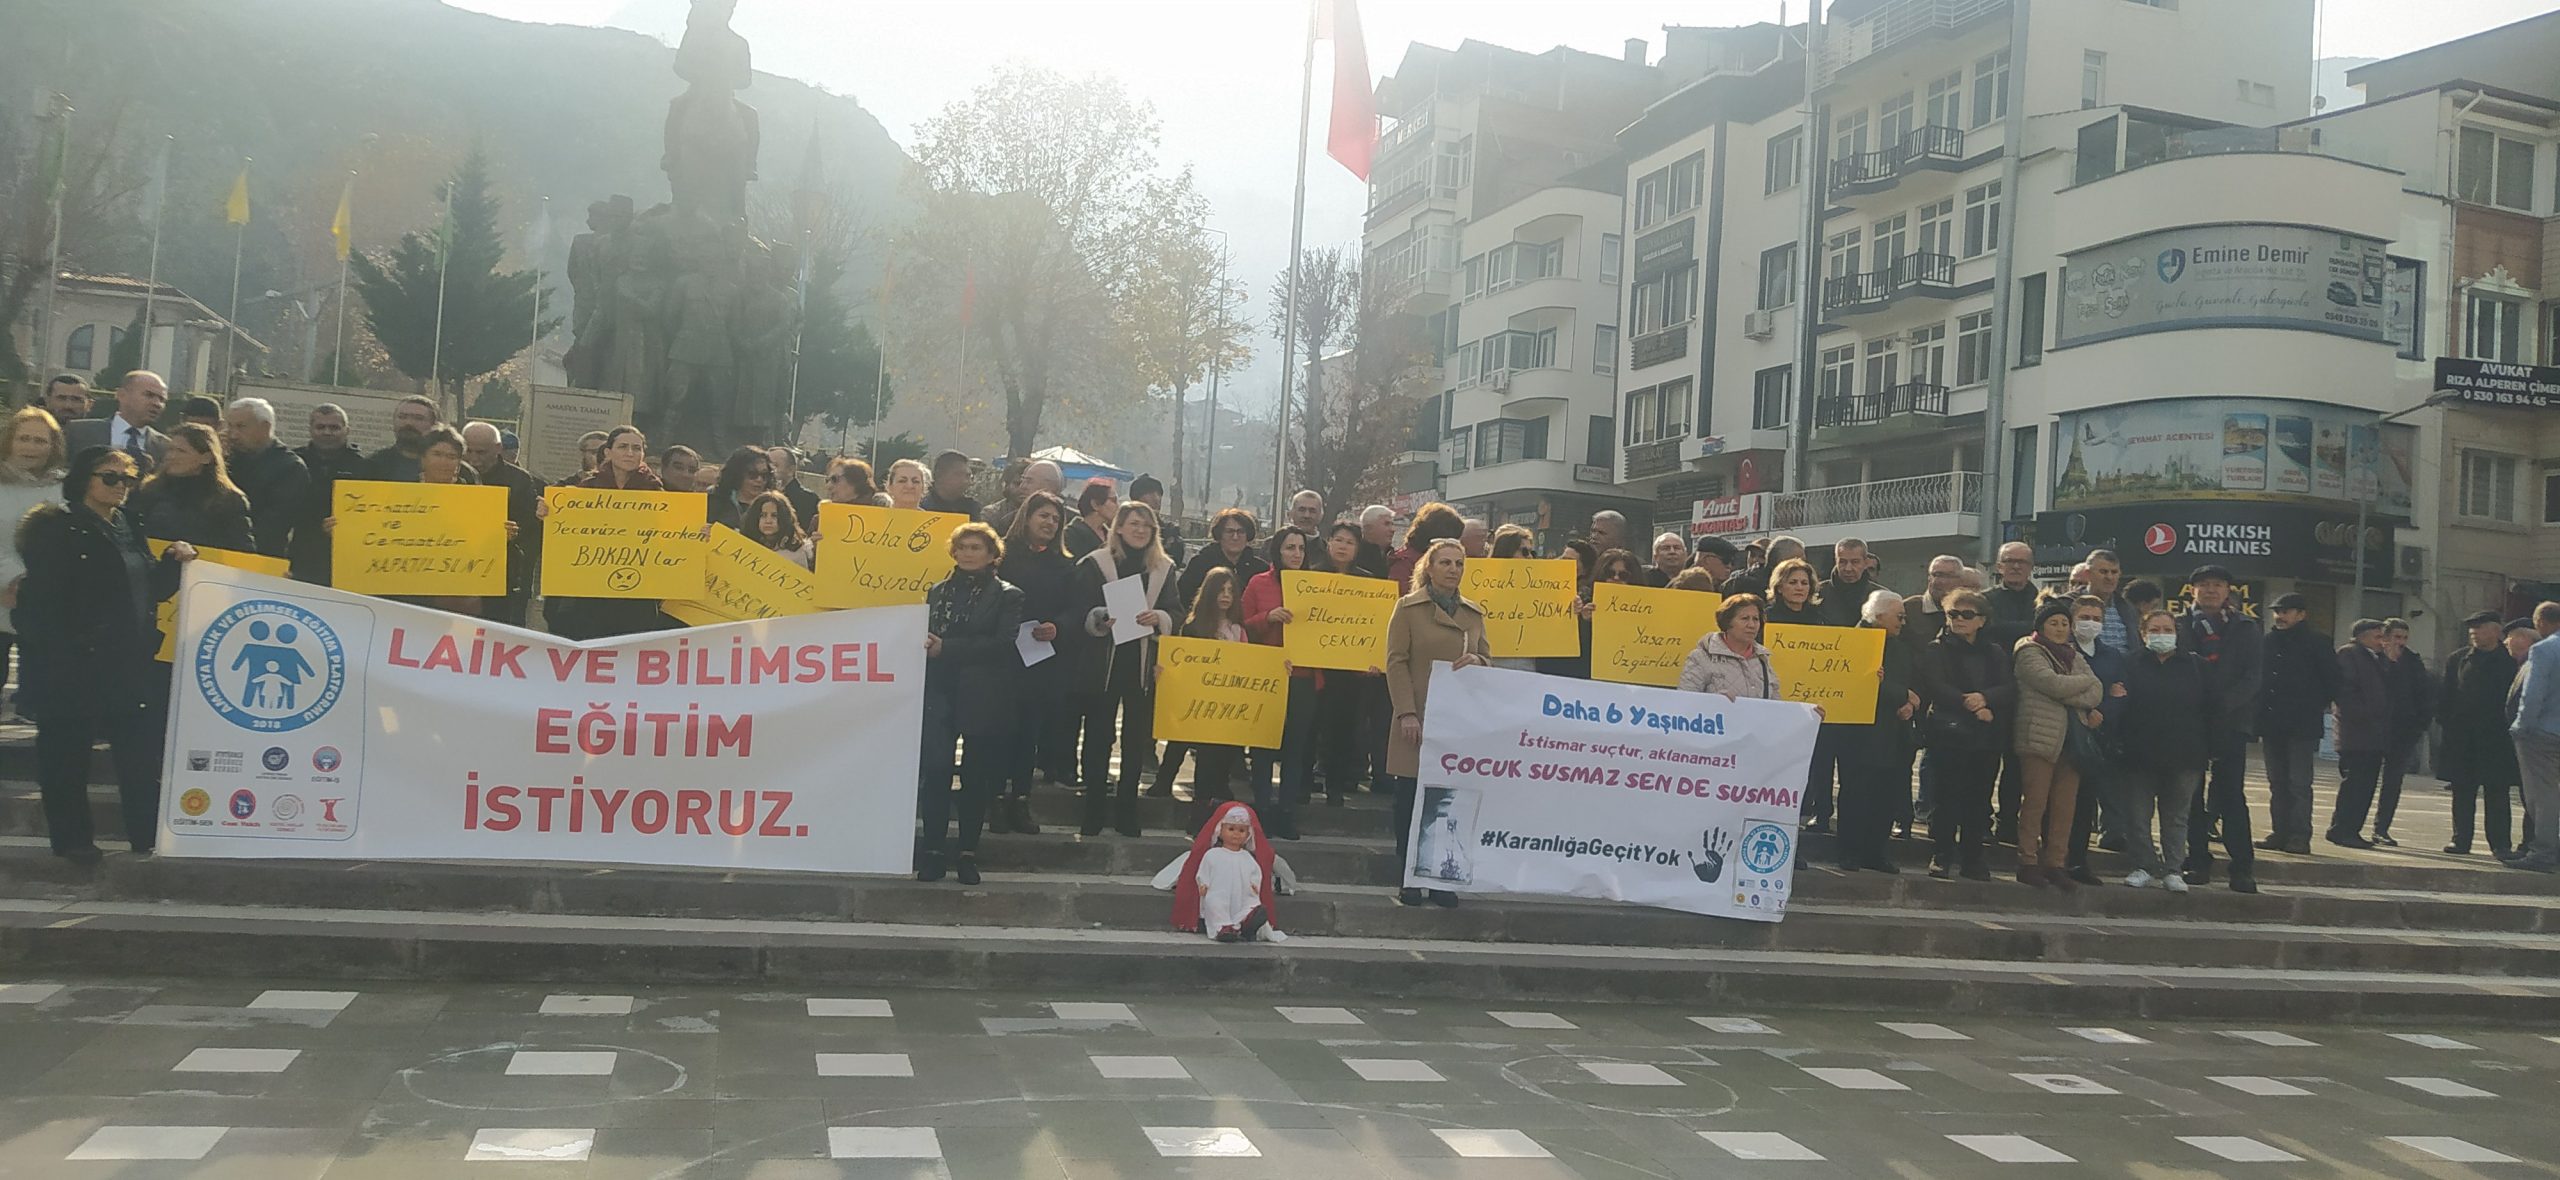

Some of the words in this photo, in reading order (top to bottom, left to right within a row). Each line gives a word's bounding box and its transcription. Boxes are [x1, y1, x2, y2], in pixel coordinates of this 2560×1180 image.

[2193, 245, 2250, 264] Emine
[2258, 244, 2309, 264] Demir
[2480, 363, 2533, 378] AVUKAT
[2446, 375, 2474, 387] RIZA
[2475, 378, 2527, 392] ALPEREN
[545, 403, 578, 413] AMASYA
[2463, 389, 2471, 400] 0
[2474, 391, 2493, 401] 530
[2496, 392, 2513, 404] 163
[2515, 394, 2531, 405] 94
[2532, 396, 2547, 407] 45
[552, 492, 669, 514] Çocuklarımız
[1703, 498, 1739, 517] Anıt
[381, 520, 402, 530] ve
[552, 520, 627, 537] Tecavüze
[841, 514, 901, 548] Daha
[908, 515, 942, 553] 6
[1691, 515, 1748, 535] LOKANTASI
[2185, 523, 2271, 540] TURKISH
[2184, 539, 2272, 556] AIRLINES
[1471, 568, 1516, 590] Çocuk
[1521, 566, 1572, 590] Susmaz
[1296, 579, 1398, 600] Çocuklarımızdan
[234, 602, 300, 620] BİLİMSEL
[1604, 595, 1654, 615] Kadın
[218, 614, 237, 629] VE
[1306, 606, 1376, 625] Ellerinizi
[200, 630, 223, 660] LAİK
[1771, 632, 1842, 651] Kamusal
[387, 627, 529, 679] LAİK
[546, 647, 617, 684] VE
[636, 636, 895, 686] BİLİMSEL
[1170, 647, 1222, 667] Çocuk
[1612, 645, 1681, 674] Özgürlük
[199, 664, 234, 714] AMASYA
[303, 655, 342, 722] PLATFORMU
[1789, 682, 1844, 701] Eğitim
[252, 719, 281, 729] 2018
[1542, 693, 1601, 725] Daha
[1605, 697, 1624, 725] 6
[1629, 706, 1726, 737] Yaşında!
[535, 701, 754, 758] EĞİTİM
[1518, 729, 1588, 754] İstismar
[1589, 742, 1645, 763] suçtur,
[1648, 745, 1737, 770] aklanamaz!
[1440, 752, 1523, 780] ÇOCUK
[1528, 762, 1621, 787] SUSMAZ
[1624, 771, 1673, 794] SEN
[1677, 776, 1711, 799] DE
[1715, 781, 1800, 809] SUSMA!
[463, 771, 809, 838] İSTİYORUZ.
[1479, 829, 1681, 869] #KaranlığaGeçitYok
